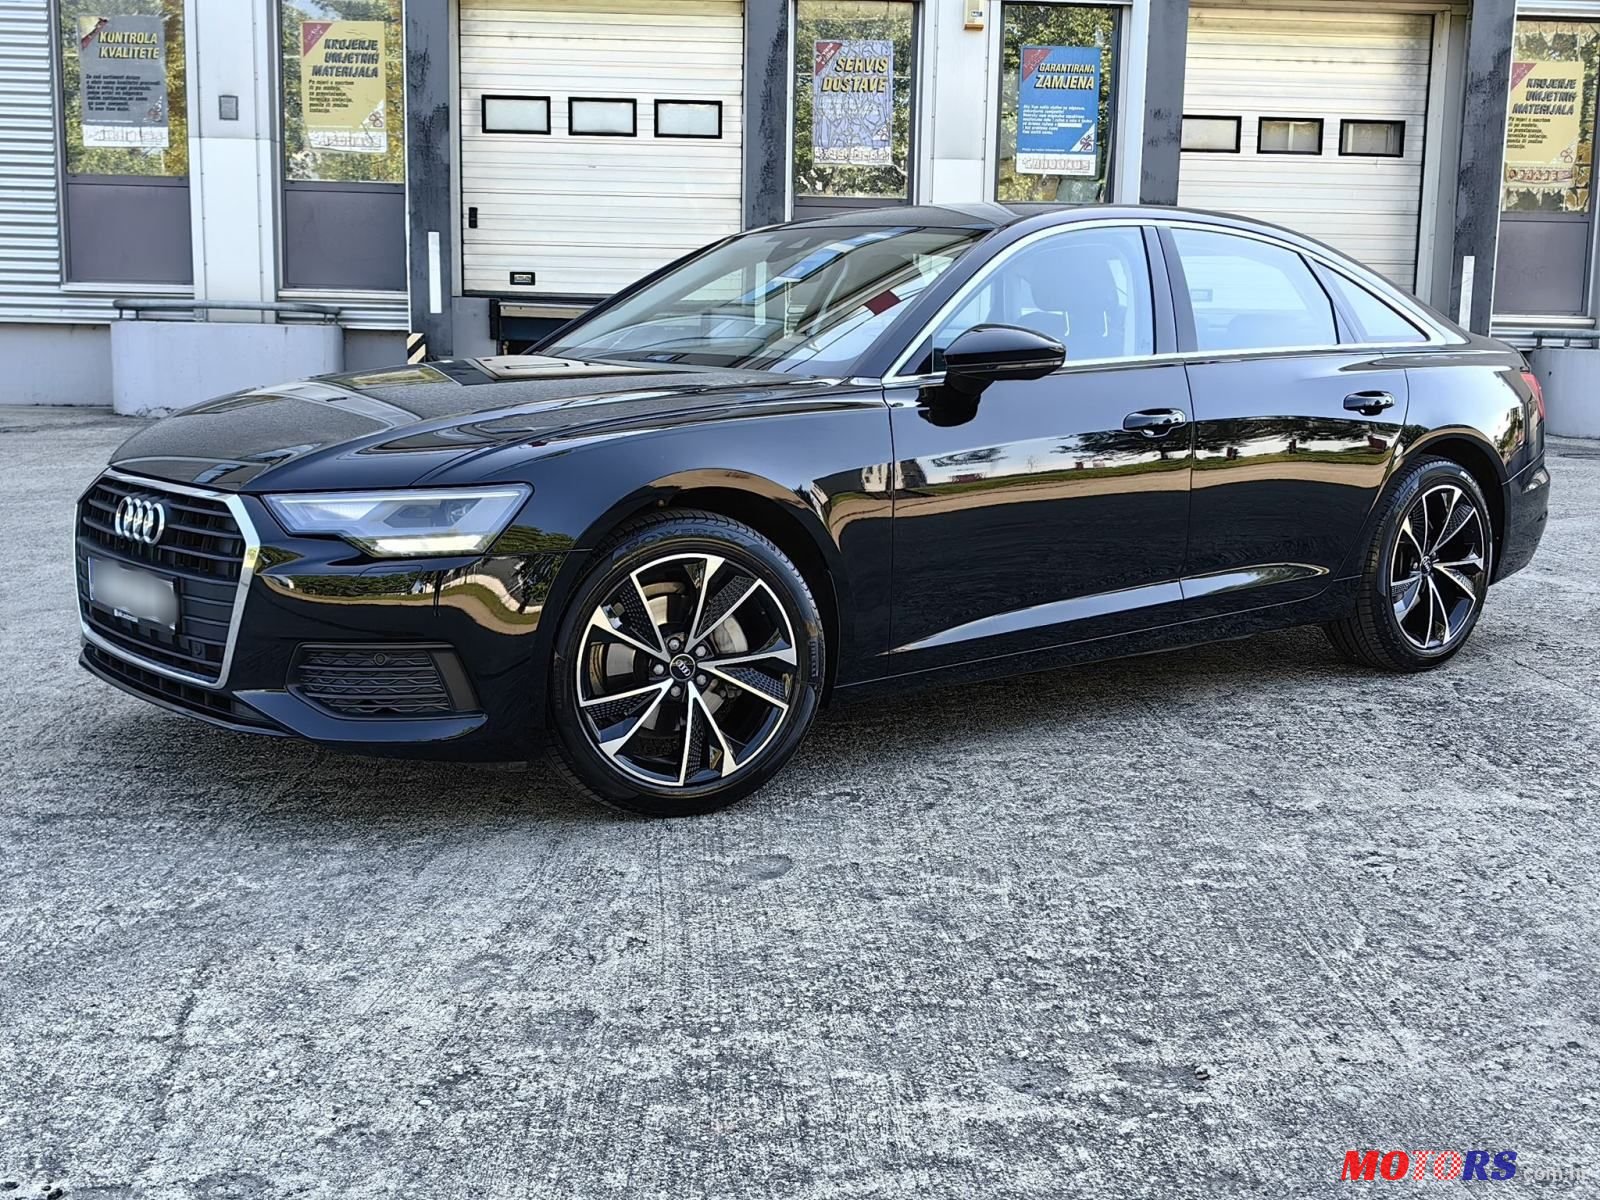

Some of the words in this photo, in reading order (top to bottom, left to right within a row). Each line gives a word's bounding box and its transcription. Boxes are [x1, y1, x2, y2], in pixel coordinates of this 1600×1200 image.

[98, 31, 158, 45] KONTROLA
[99, 46, 160, 60] KVALITETE
[311, 64, 378, 78] MATERIJALA
[835, 56, 888, 74] SERVIS
[1038, 62, 1095, 74] GARANTIRANA
[821, 76, 888, 93] DOSTAVE
[1034, 74, 1095, 90] ZAMJENA
